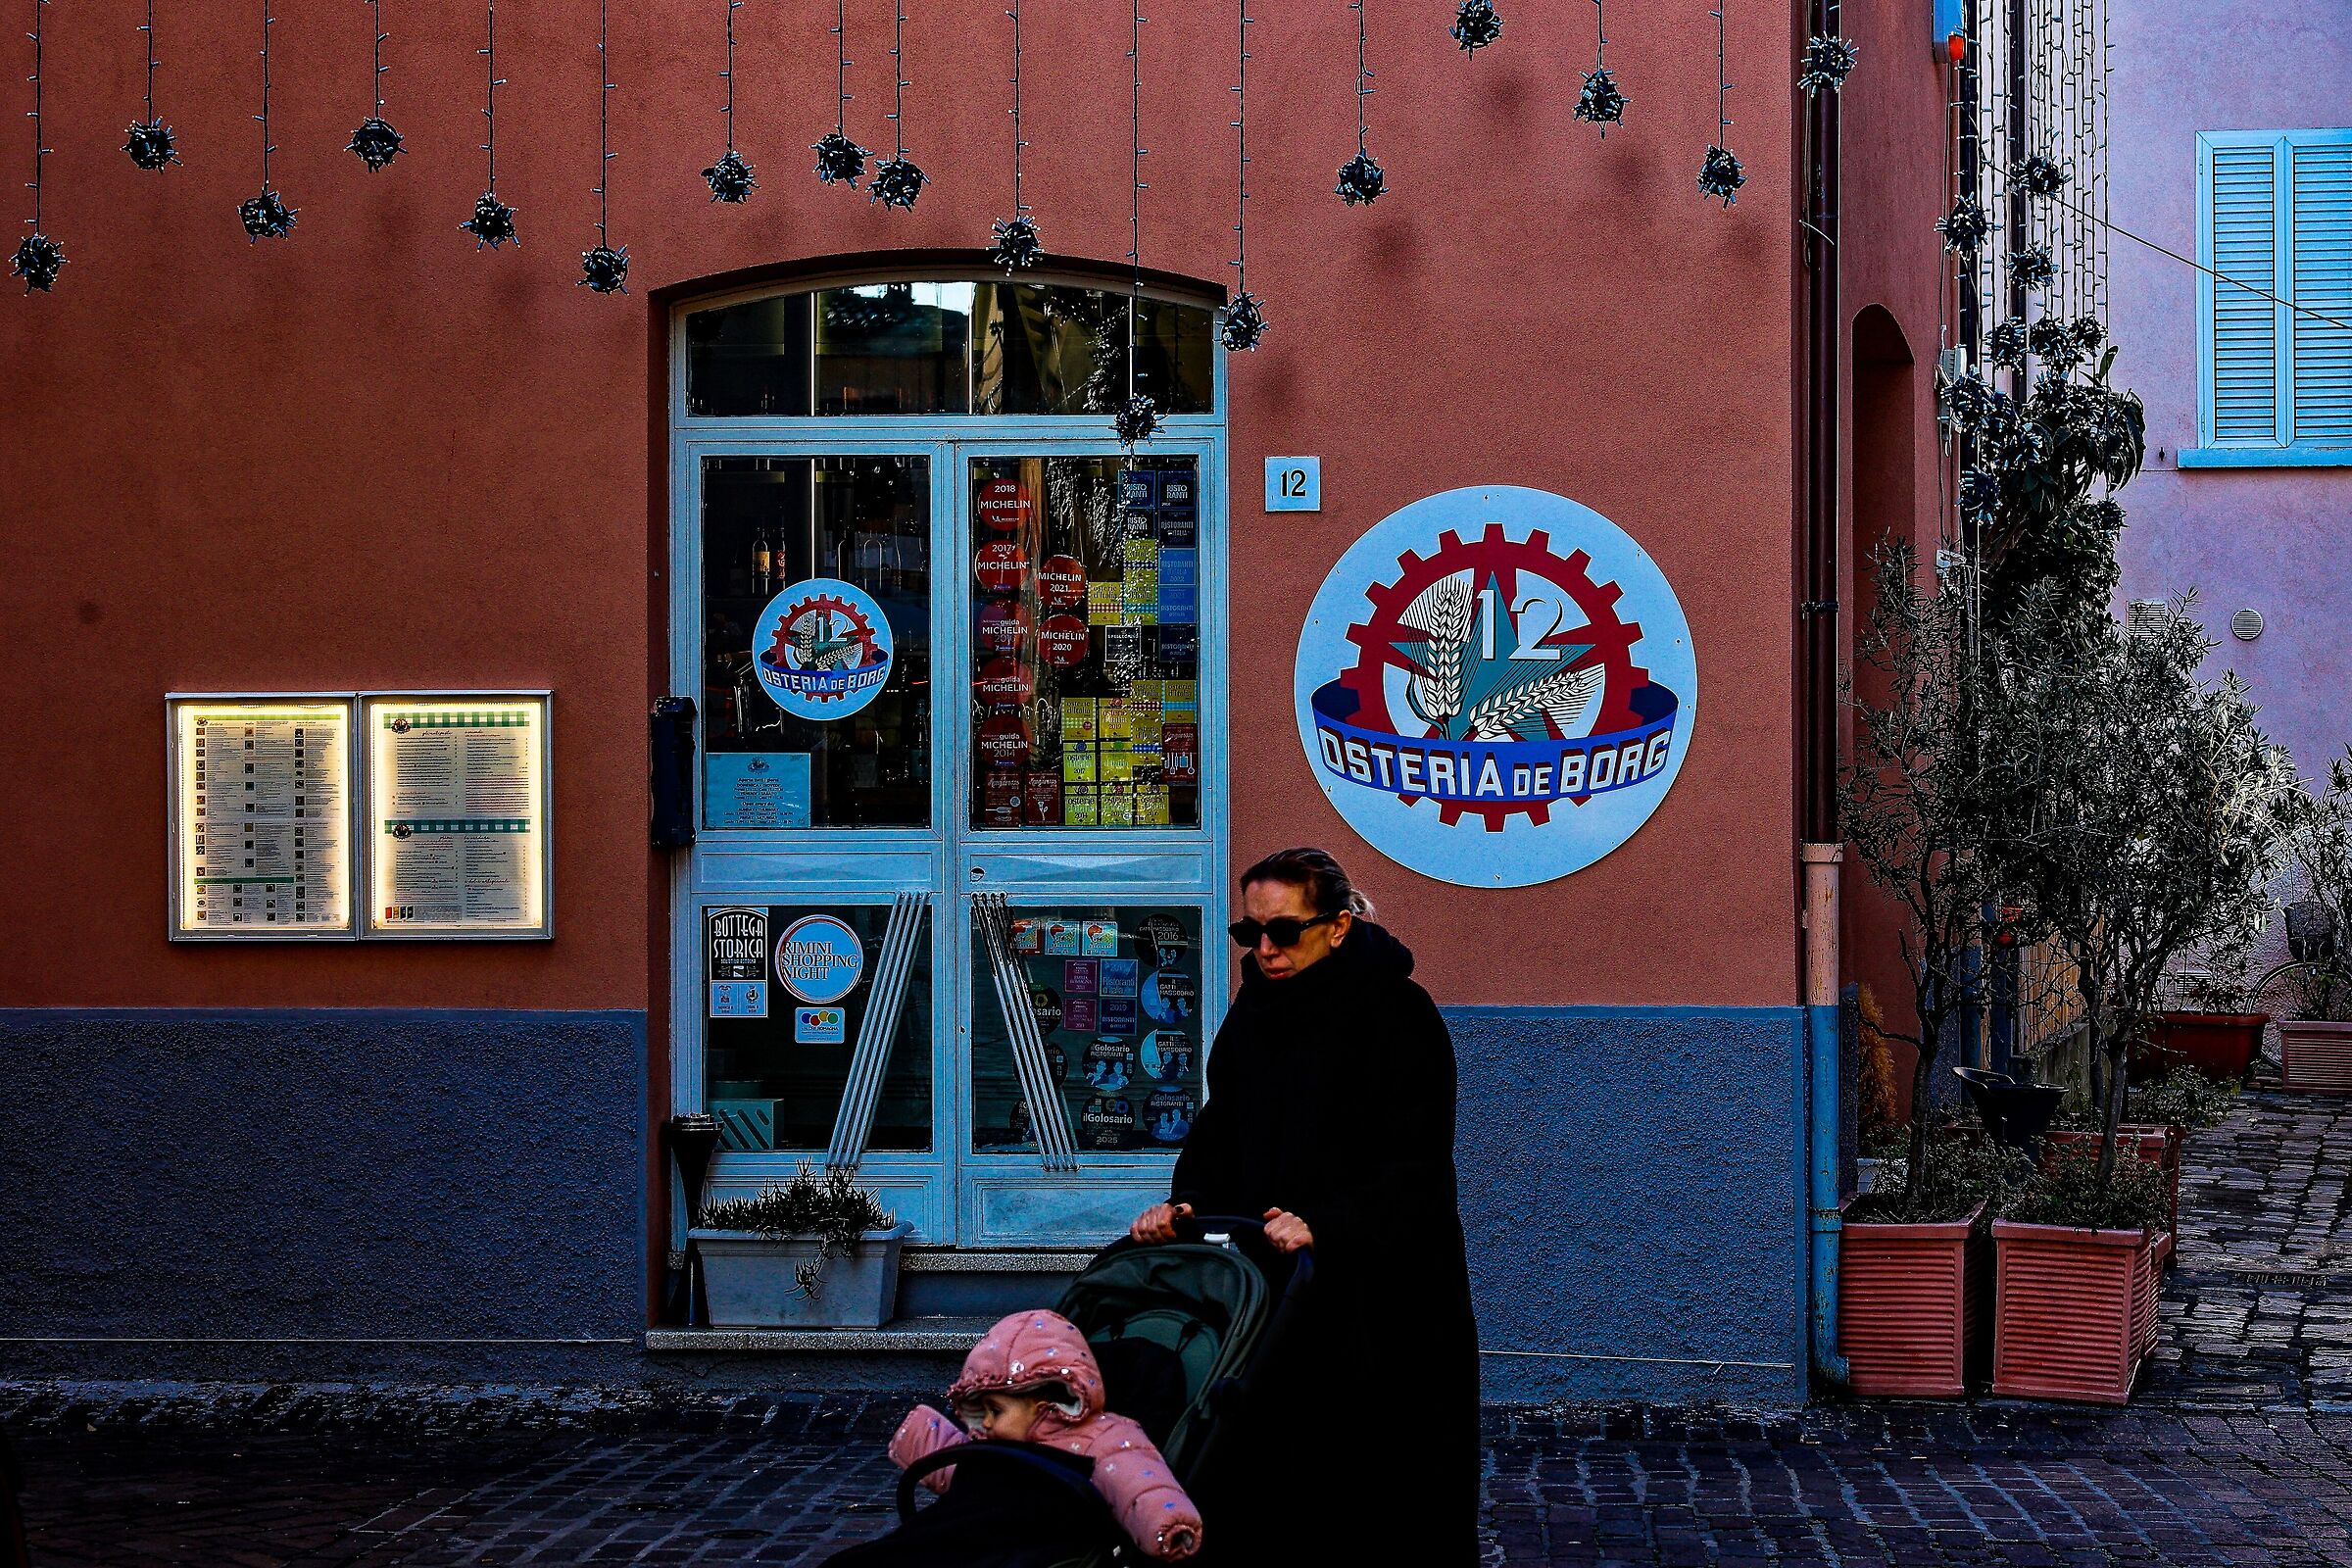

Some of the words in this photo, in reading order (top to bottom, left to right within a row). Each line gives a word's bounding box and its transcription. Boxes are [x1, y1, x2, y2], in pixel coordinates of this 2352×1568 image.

[1280, 469, 1307, 497] 12
[994, 484, 1016, 493] 2018
[980, 500, 1031, 509] MICHELIN
[992, 544, 1012, 553] 2017
[1038, 572, 1082, 582] MICHELIN
[1050, 583, 1069, 592] 2021
[1000, 618, 1020, 627] guida
[1475, 588, 1564, 662] 12
[816, 616, 850, 643] 12
[1041, 631, 1085, 641] MICHELIN
[762, 667, 828, 691] OSTERIA
[830, 679, 846, 690] DE
[848, 665, 886, 689] BORG
[982, 683, 1029, 692] MICHELIN
[999, 732, 1020, 741] guida
[981, 740, 1028, 749] MICHELIN
[993, 749, 1015, 758] 2014
[1318, 727, 1504, 798] OSTERIA
[1513, 763, 1552, 797] DE
[1560, 727, 1671, 797] BORG
[713, 914, 763, 937] BOTTEGA
[1157, 931, 1179, 941] 2016
[713, 938, 763, 958] STORICA
[784, 941, 832, 955] RIMINI
[782, 954, 858, 968] SHOPPING
[783, 966, 830, 980] NIGHT
[1083, 1113, 1133, 1124] ilGolosario
